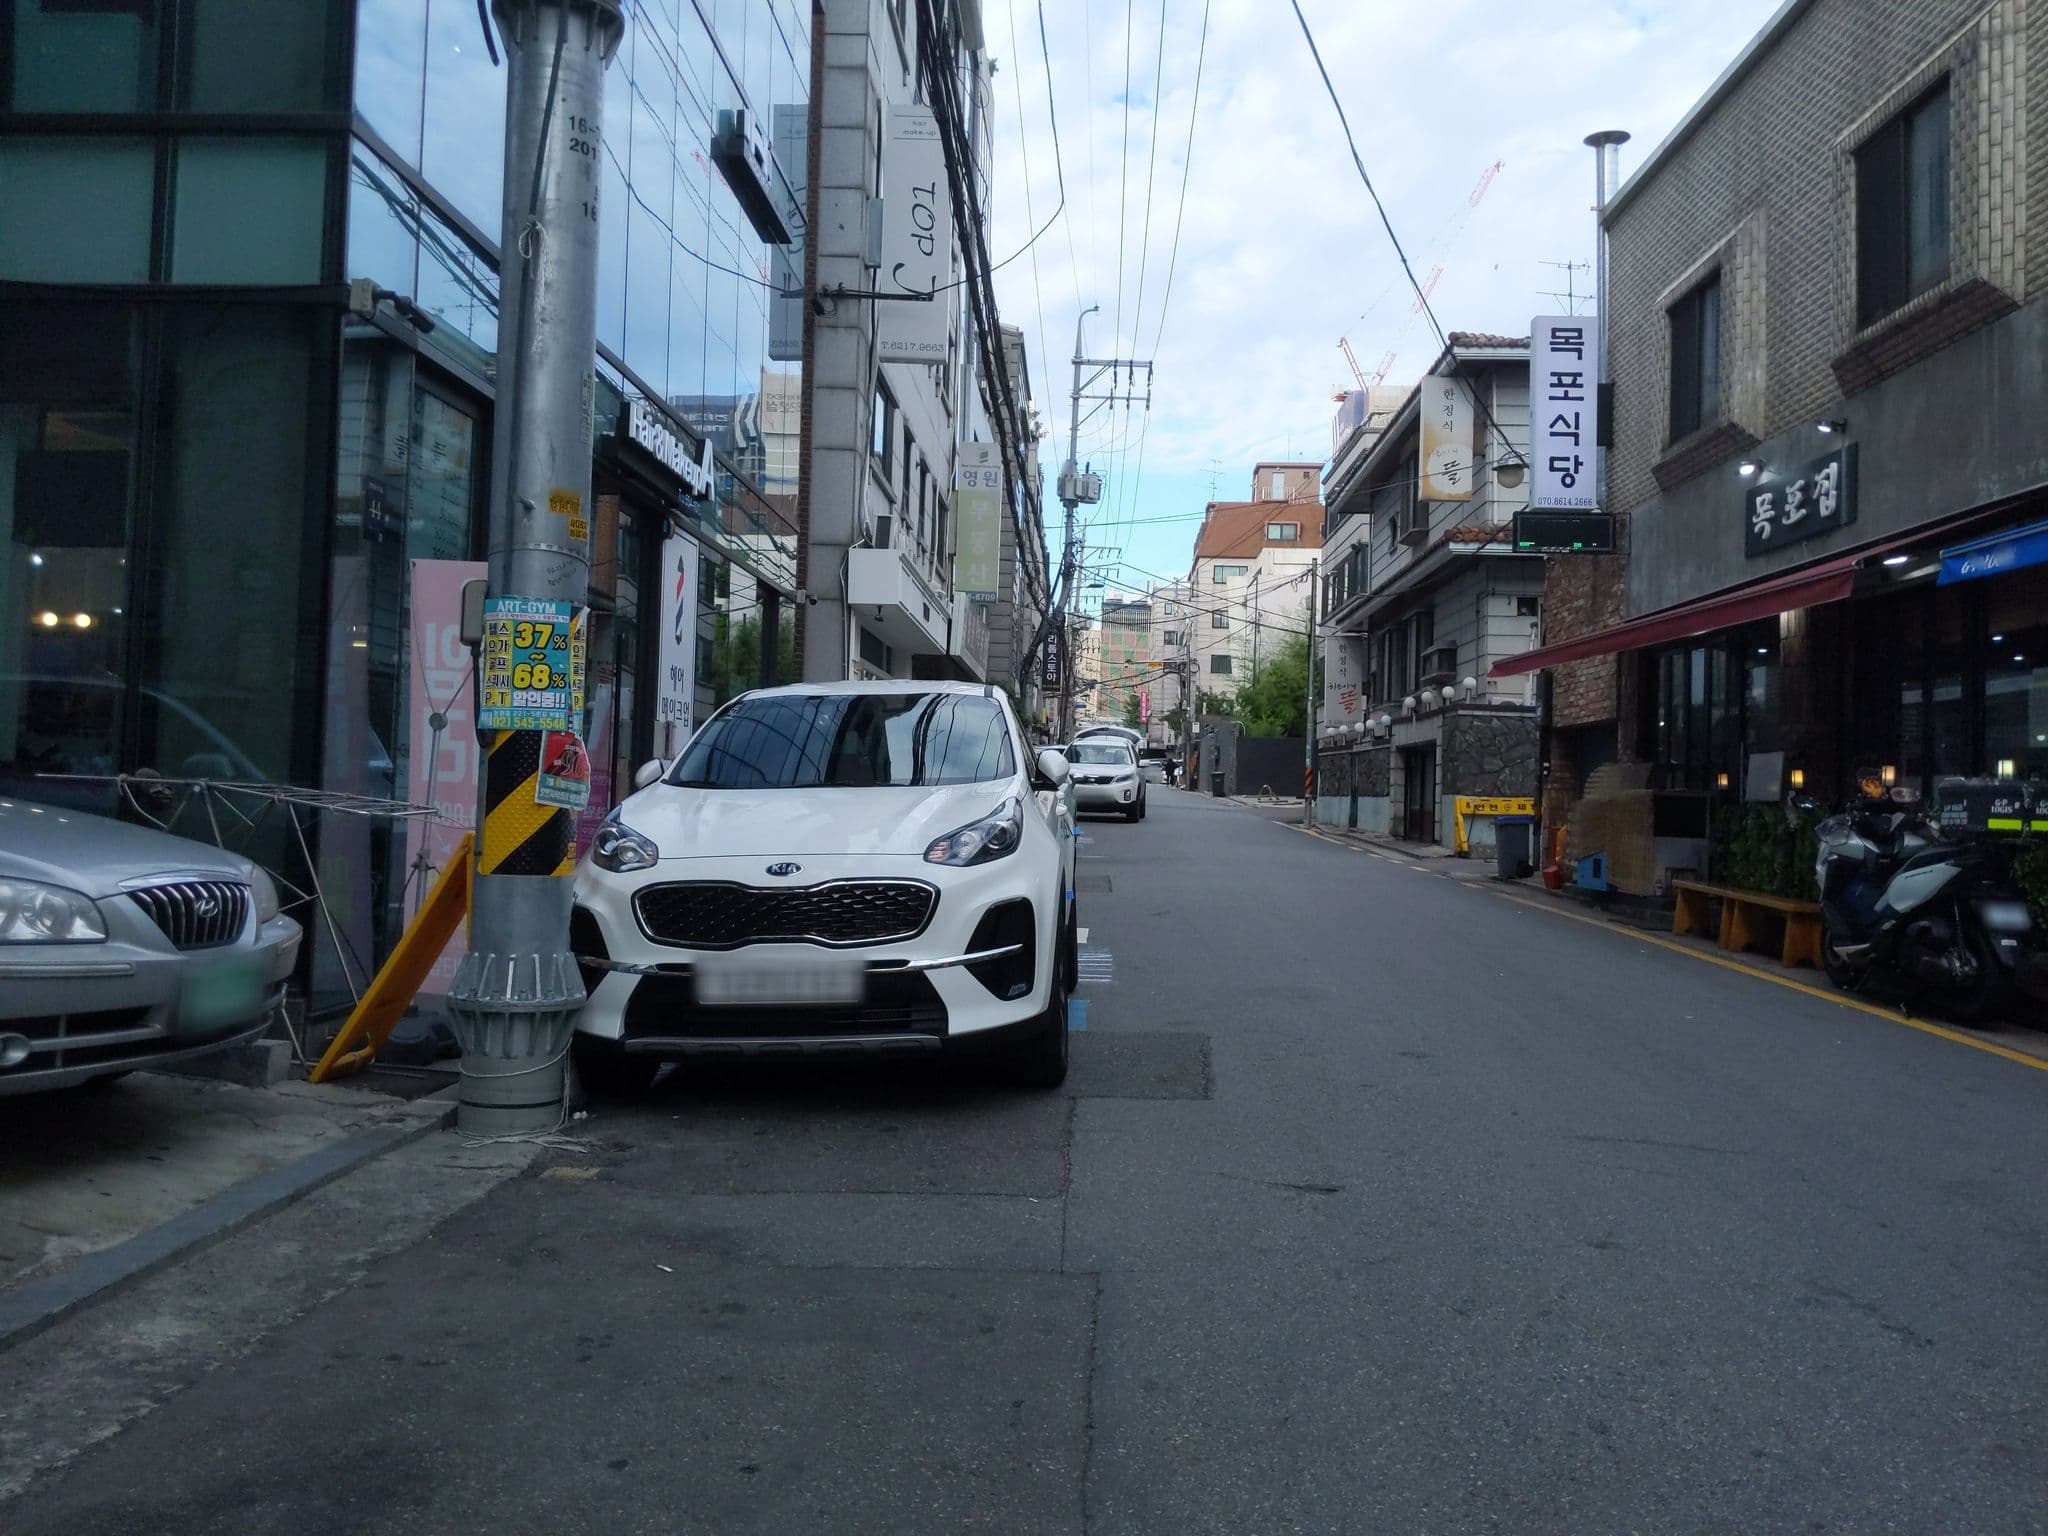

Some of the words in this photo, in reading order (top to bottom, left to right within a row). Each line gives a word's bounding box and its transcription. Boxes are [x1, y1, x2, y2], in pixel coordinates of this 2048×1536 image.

[1442, 386, 1456, 433] 한정식
[1548, 326, 1585, 489] 목포식당
[962, 469, 999, 488] 영원
[1752, 462, 1839, 540] 목포집
[496, 601, 556, 614] ART-GYM
[487, 639, 510, 654] 요가
[514, 622, 568, 650] 37%
[512, 662, 566, 690] 68%
[669, 663, 685, 693] 헤어
[771, 863, 797, 873] KIA
